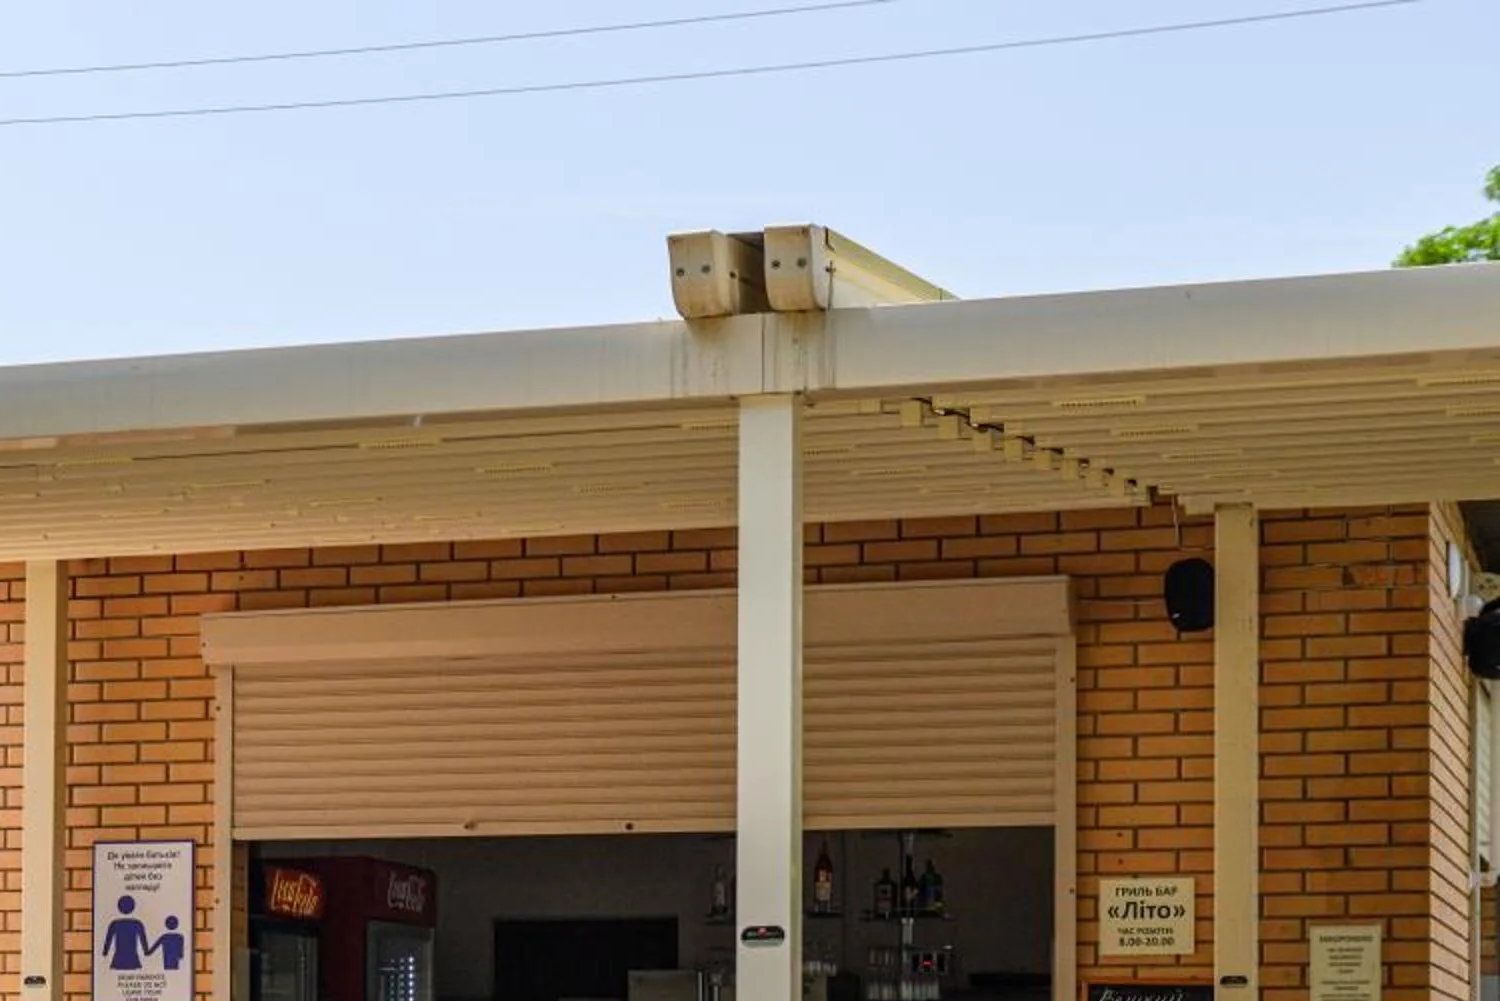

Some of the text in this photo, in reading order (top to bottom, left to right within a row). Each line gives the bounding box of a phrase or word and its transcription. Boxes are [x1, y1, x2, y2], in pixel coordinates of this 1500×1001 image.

[1115, 885, 1178, 897] ГРИЛЬ БАР
[1107, 900, 1186, 920] «Літо»
